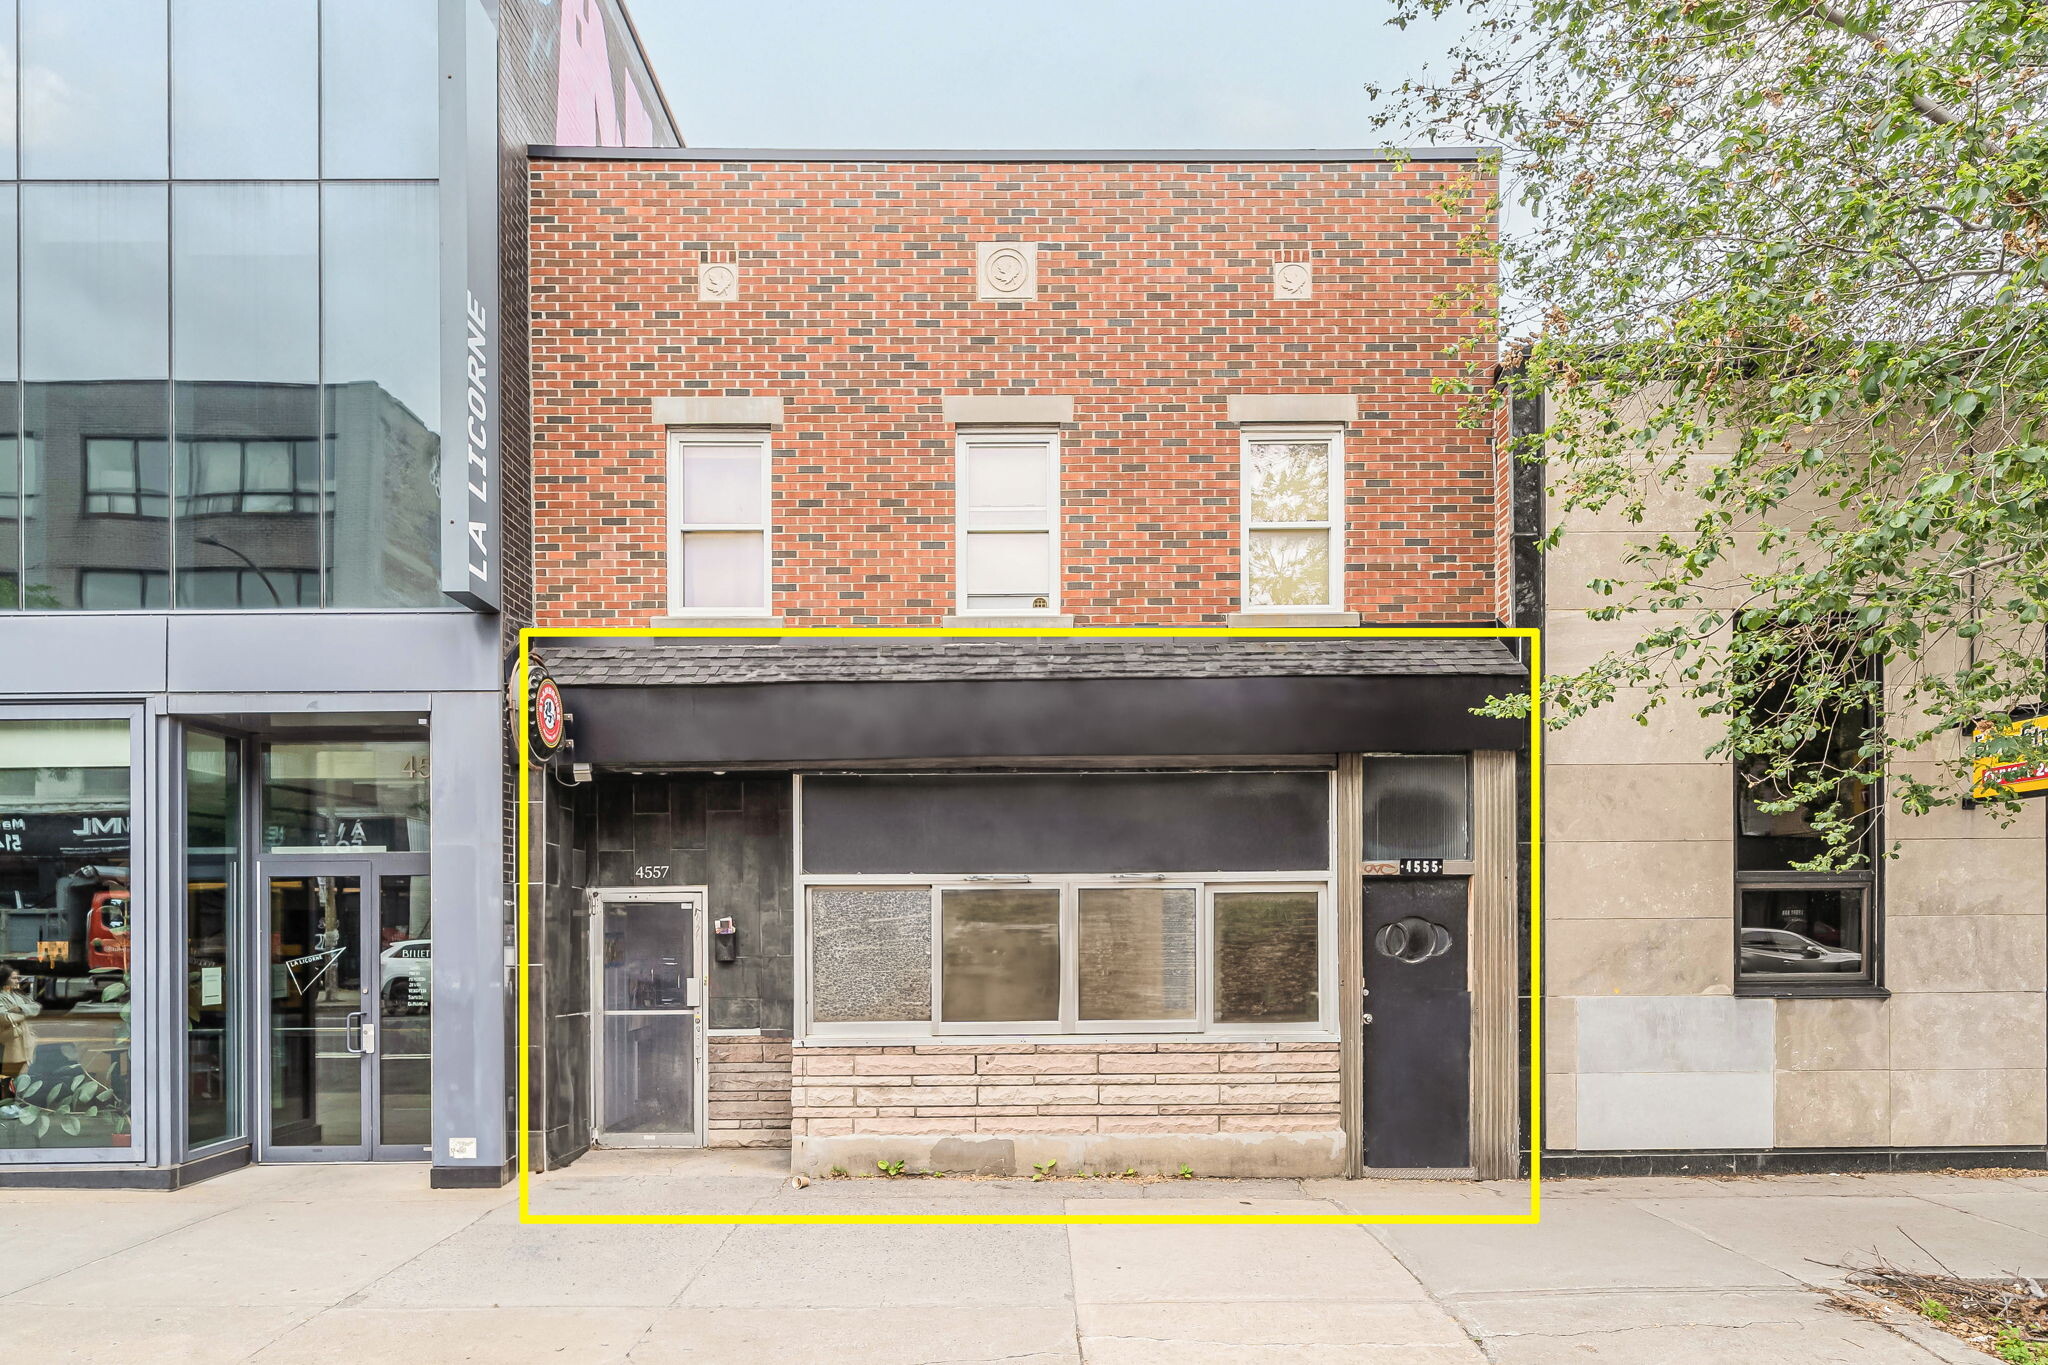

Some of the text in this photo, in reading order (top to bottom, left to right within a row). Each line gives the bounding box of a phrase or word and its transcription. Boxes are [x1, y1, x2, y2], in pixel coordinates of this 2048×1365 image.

[467, 290, 488, 582] LA LICORNE
[635, 865, 670, 879] 4557
[1405, 860, 1439, 874] 4555
[290, 959, 300, 968] LA
